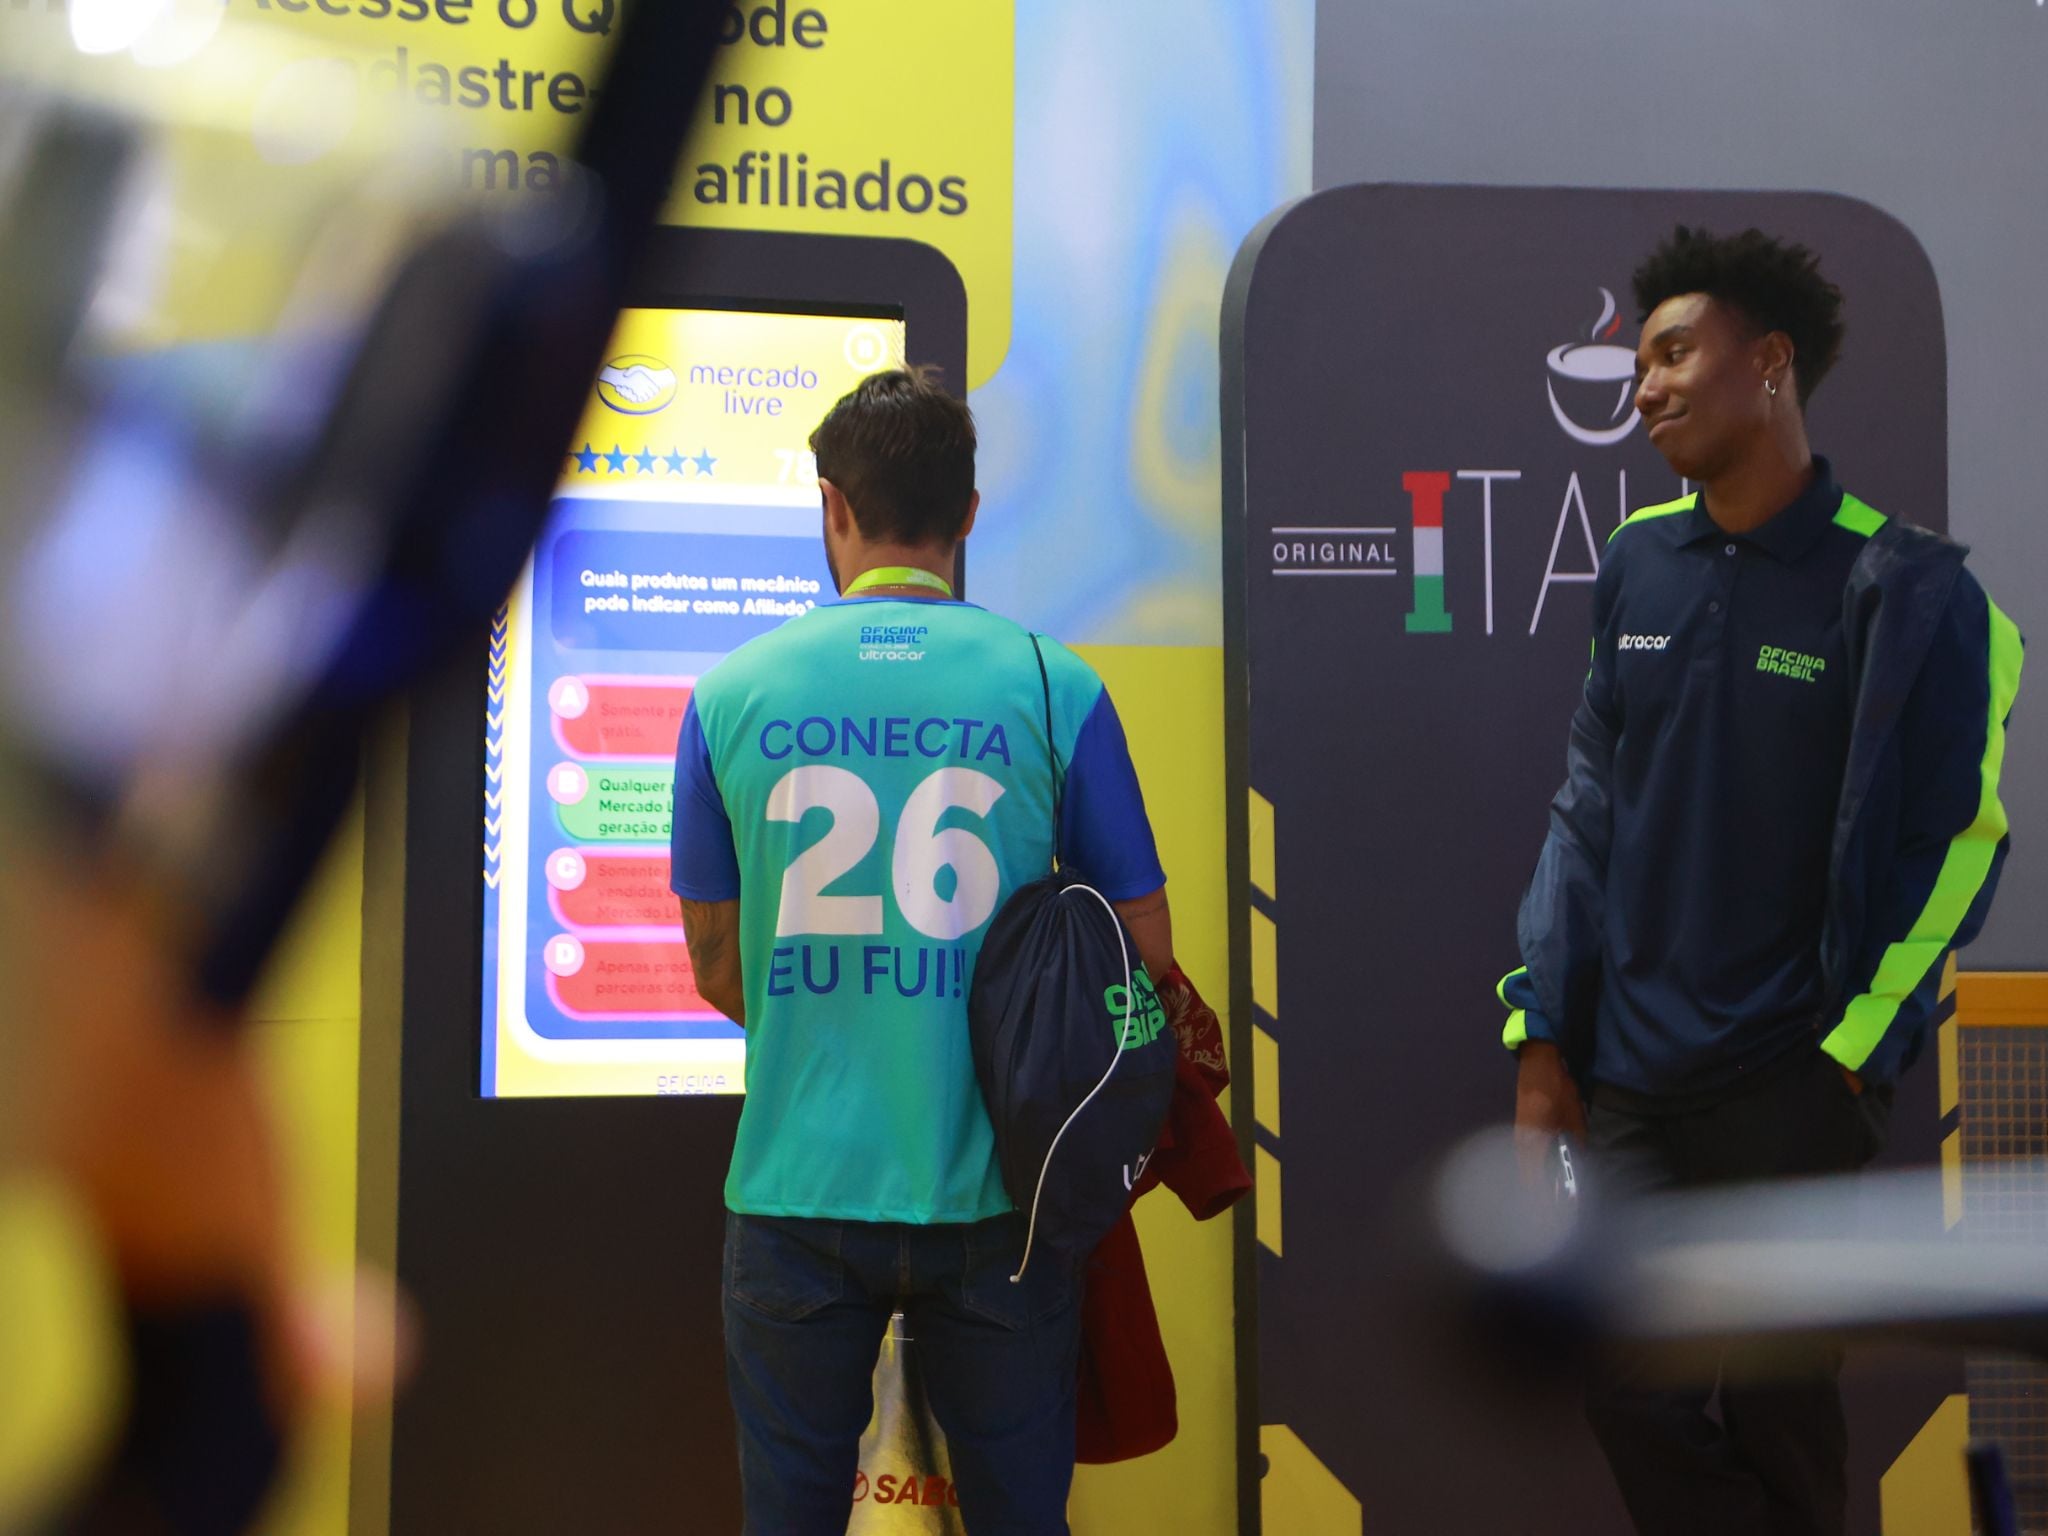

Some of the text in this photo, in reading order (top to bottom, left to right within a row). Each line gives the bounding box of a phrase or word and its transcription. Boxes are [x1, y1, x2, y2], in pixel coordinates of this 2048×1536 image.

[718, 0, 827, 49] ode
[714, 83, 793, 127] no
[694, 151, 969, 216] afiliados
[689, 363, 819, 390] mercado
[723, 391, 783, 416] livre
[1272, 543, 1396, 563] ORIGINAL
[580, 569, 820, 594] Quais produtos um mecânico
[584, 594, 629, 613] pode
[632, 594, 690, 613] indicar
[693, 599, 740, 615] como
[860, 635, 921, 644] BRASIL
[861, 626, 928, 634] OFICINA
[1618, 634, 1671, 650] ultracar
[859, 649, 926, 660] ultracar
[1759, 645, 1826, 672] OFICINA
[1756, 657, 1815, 682] BRASIL
[760, 716, 1012, 766] CONECTA
[599, 779, 666, 794] Qualquer
[599, 800, 663, 813] Mercado
[599, 821, 658, 836] geração
[766, 764, 1006, 940] 26
[596, 960, 650, 975] Apenas
[767, 945, 839, 997] EU
[657, 1075, 726, 1088] OFICINA
